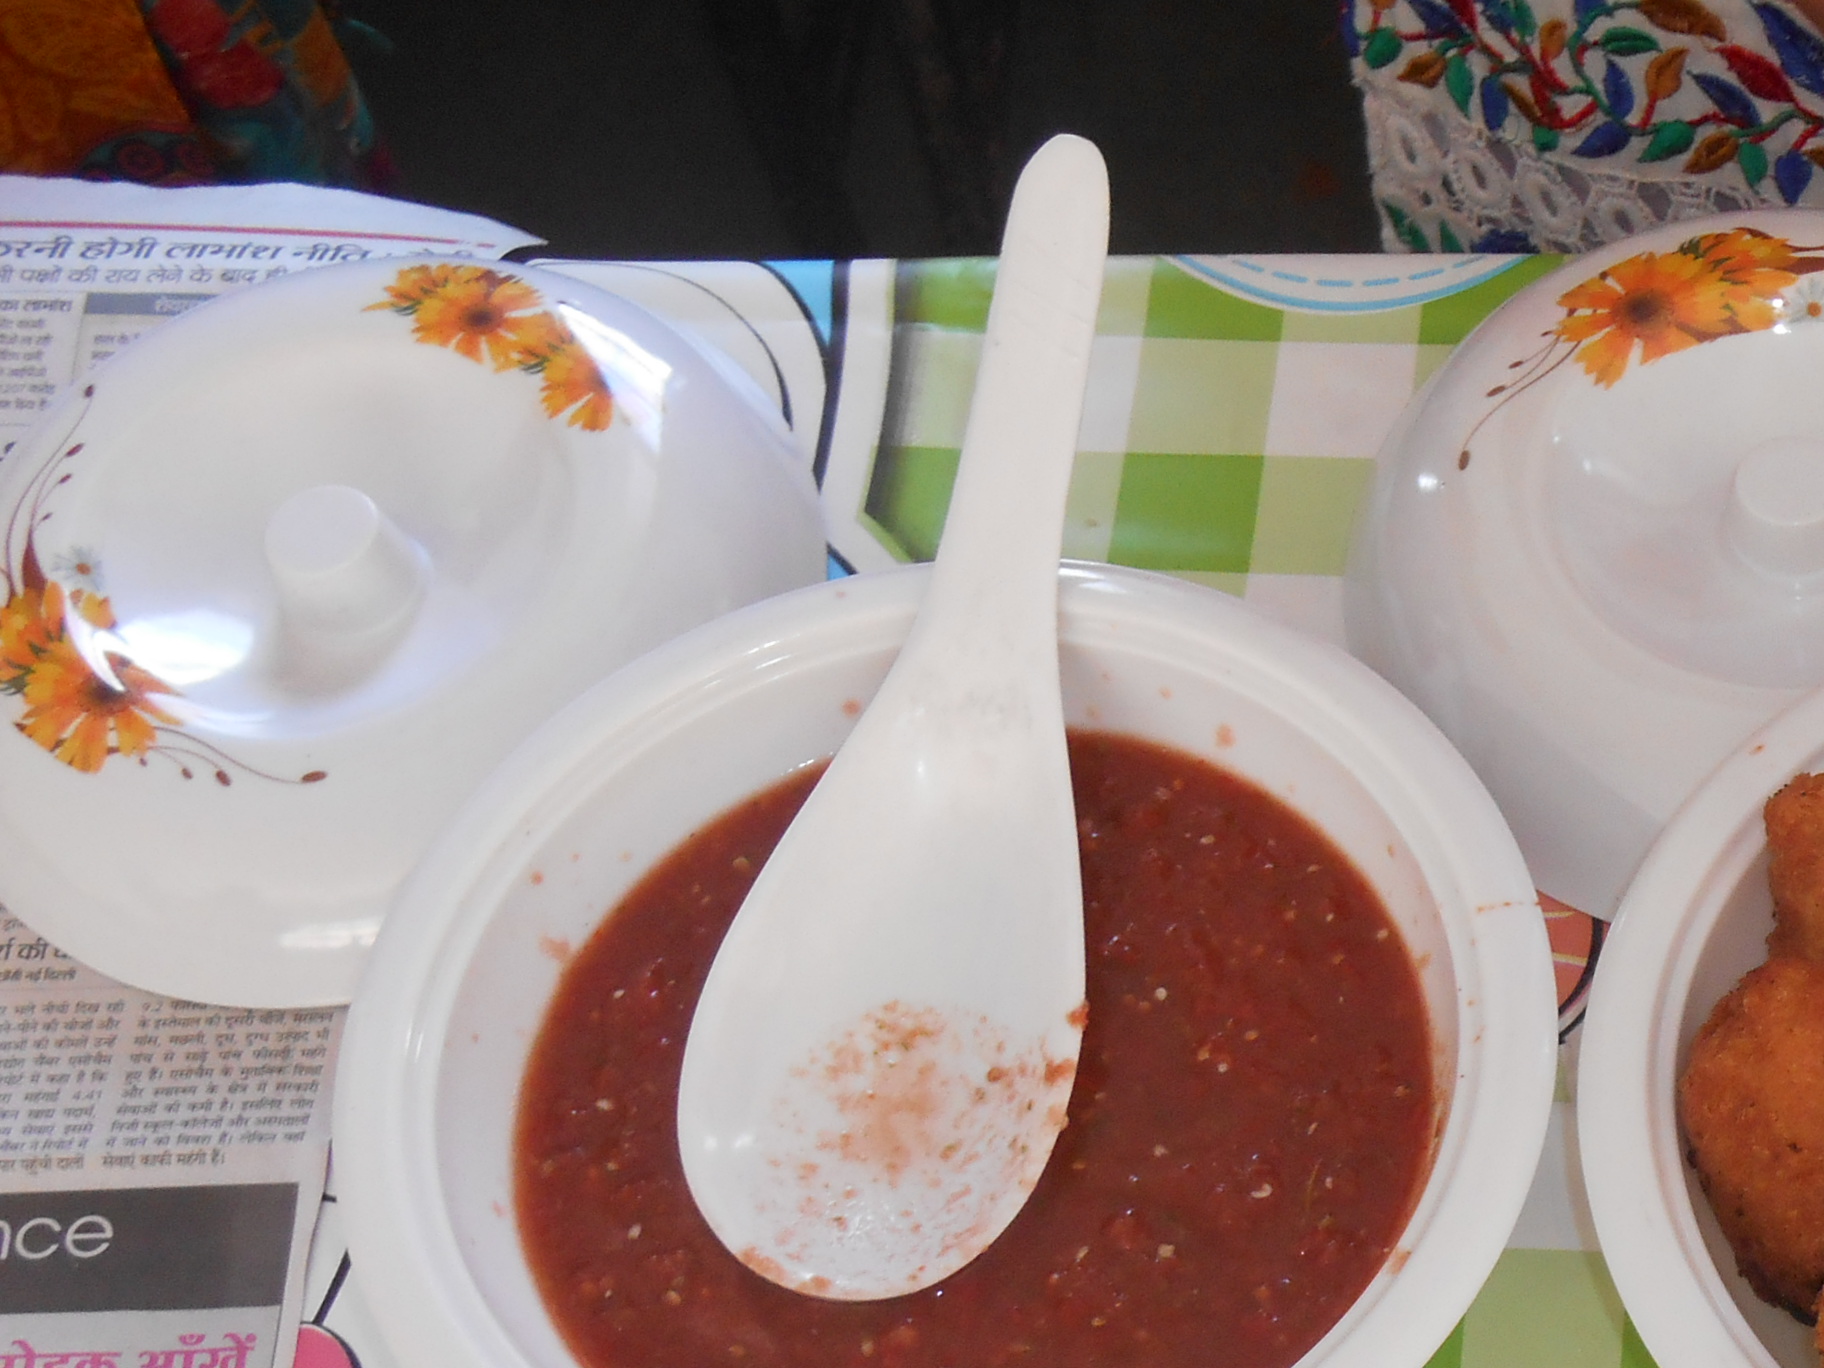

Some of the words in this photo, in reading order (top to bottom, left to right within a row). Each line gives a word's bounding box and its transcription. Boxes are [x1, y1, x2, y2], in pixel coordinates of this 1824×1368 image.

[79, 236, 158, 260] होगी
[165, 241, 284, 260] लाभांश
[67, 264, 98, 284] की
[104, 268, 141, 285] राय
[146, 264, 184, 284] लेने
[189, 264, 213, 284] के
[220, 267, 257, 284] बाद
[18, 936, 50, 960] की
